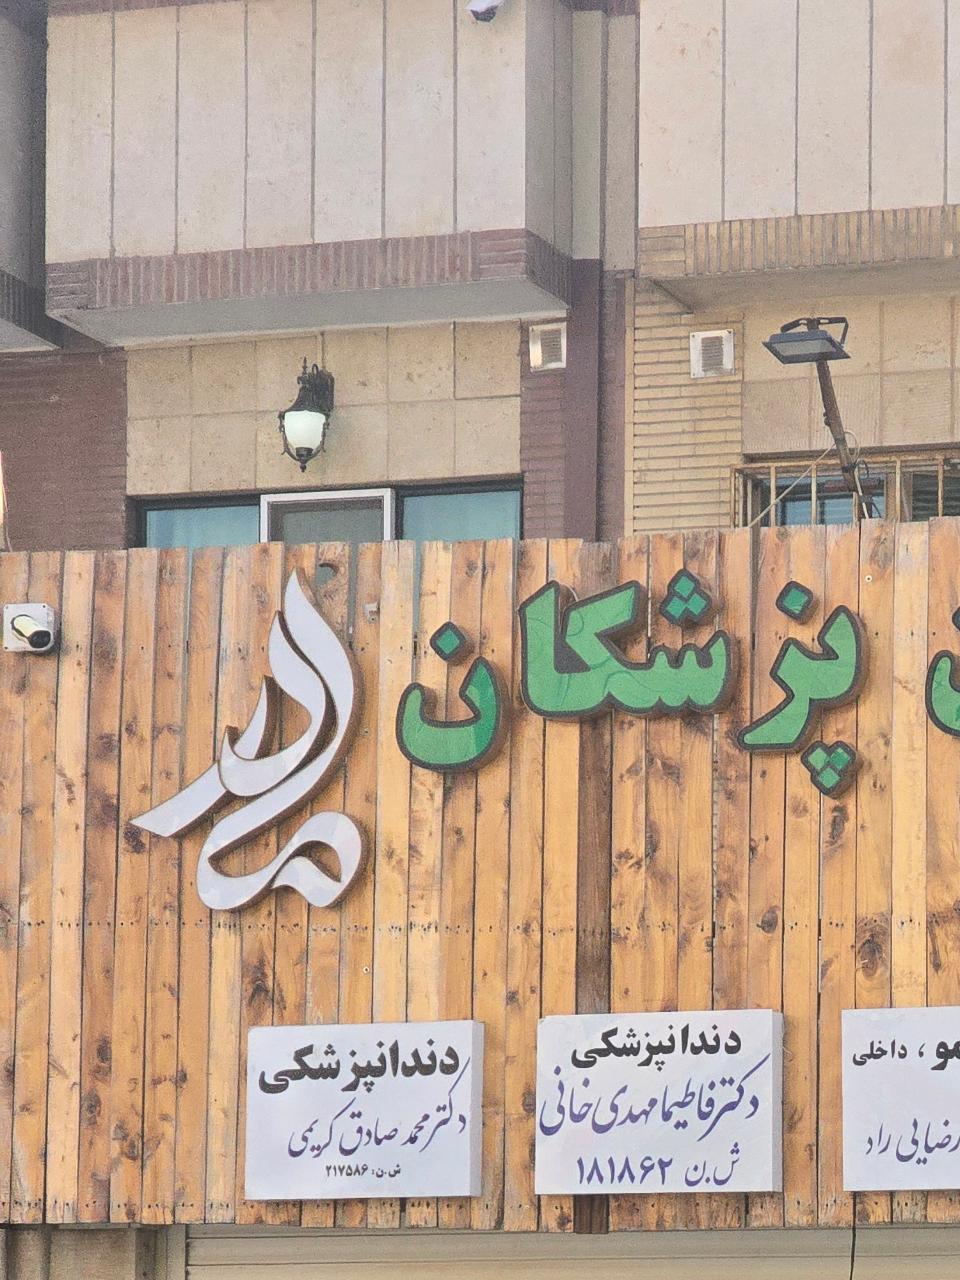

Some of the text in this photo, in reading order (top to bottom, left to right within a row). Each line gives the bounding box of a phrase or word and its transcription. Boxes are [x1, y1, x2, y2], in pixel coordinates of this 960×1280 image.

[395, 567, 867, 799] پزشکان
[258, 1037, 460, 1095] دندانپزشکی
[571, 1023, 742, 1071] دندانپزشکی
[852, 1039, 908, 1067] داخلی
[287, 1057, 471, 1159] دکتر محمد صادق کریمی
[697, 1053, 771, 1142] دکتر
[865, 1122, 892, 1156] راد
[326, 1163, 369, 1178] ۲۱۷۵۸۶
[576, 1156, 673, 1185] ۱۸۱۸۶۲
